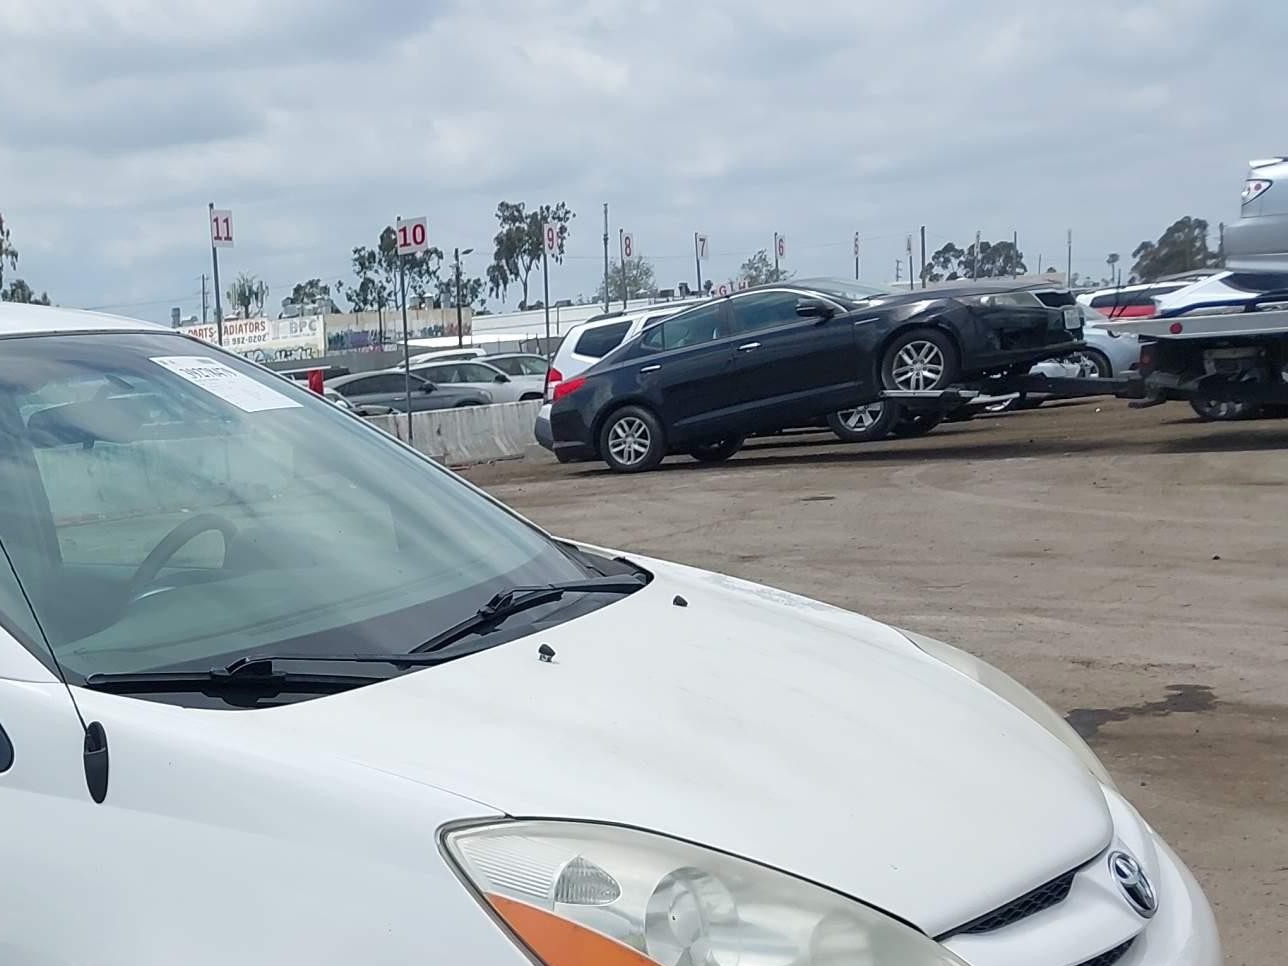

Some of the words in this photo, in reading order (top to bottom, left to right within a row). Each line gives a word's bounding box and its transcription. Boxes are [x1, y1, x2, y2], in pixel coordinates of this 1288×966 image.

[213, 216, 232, 241] 11
[398, 223, 426, 248] 10
[547, 227, 554, 250] 9
[624, 236, 632, 257] 8
[698, 238, 706, 257] 7
[778, 238, 785, 257] 6
[223, 320, 266, 336] ADIATORS
